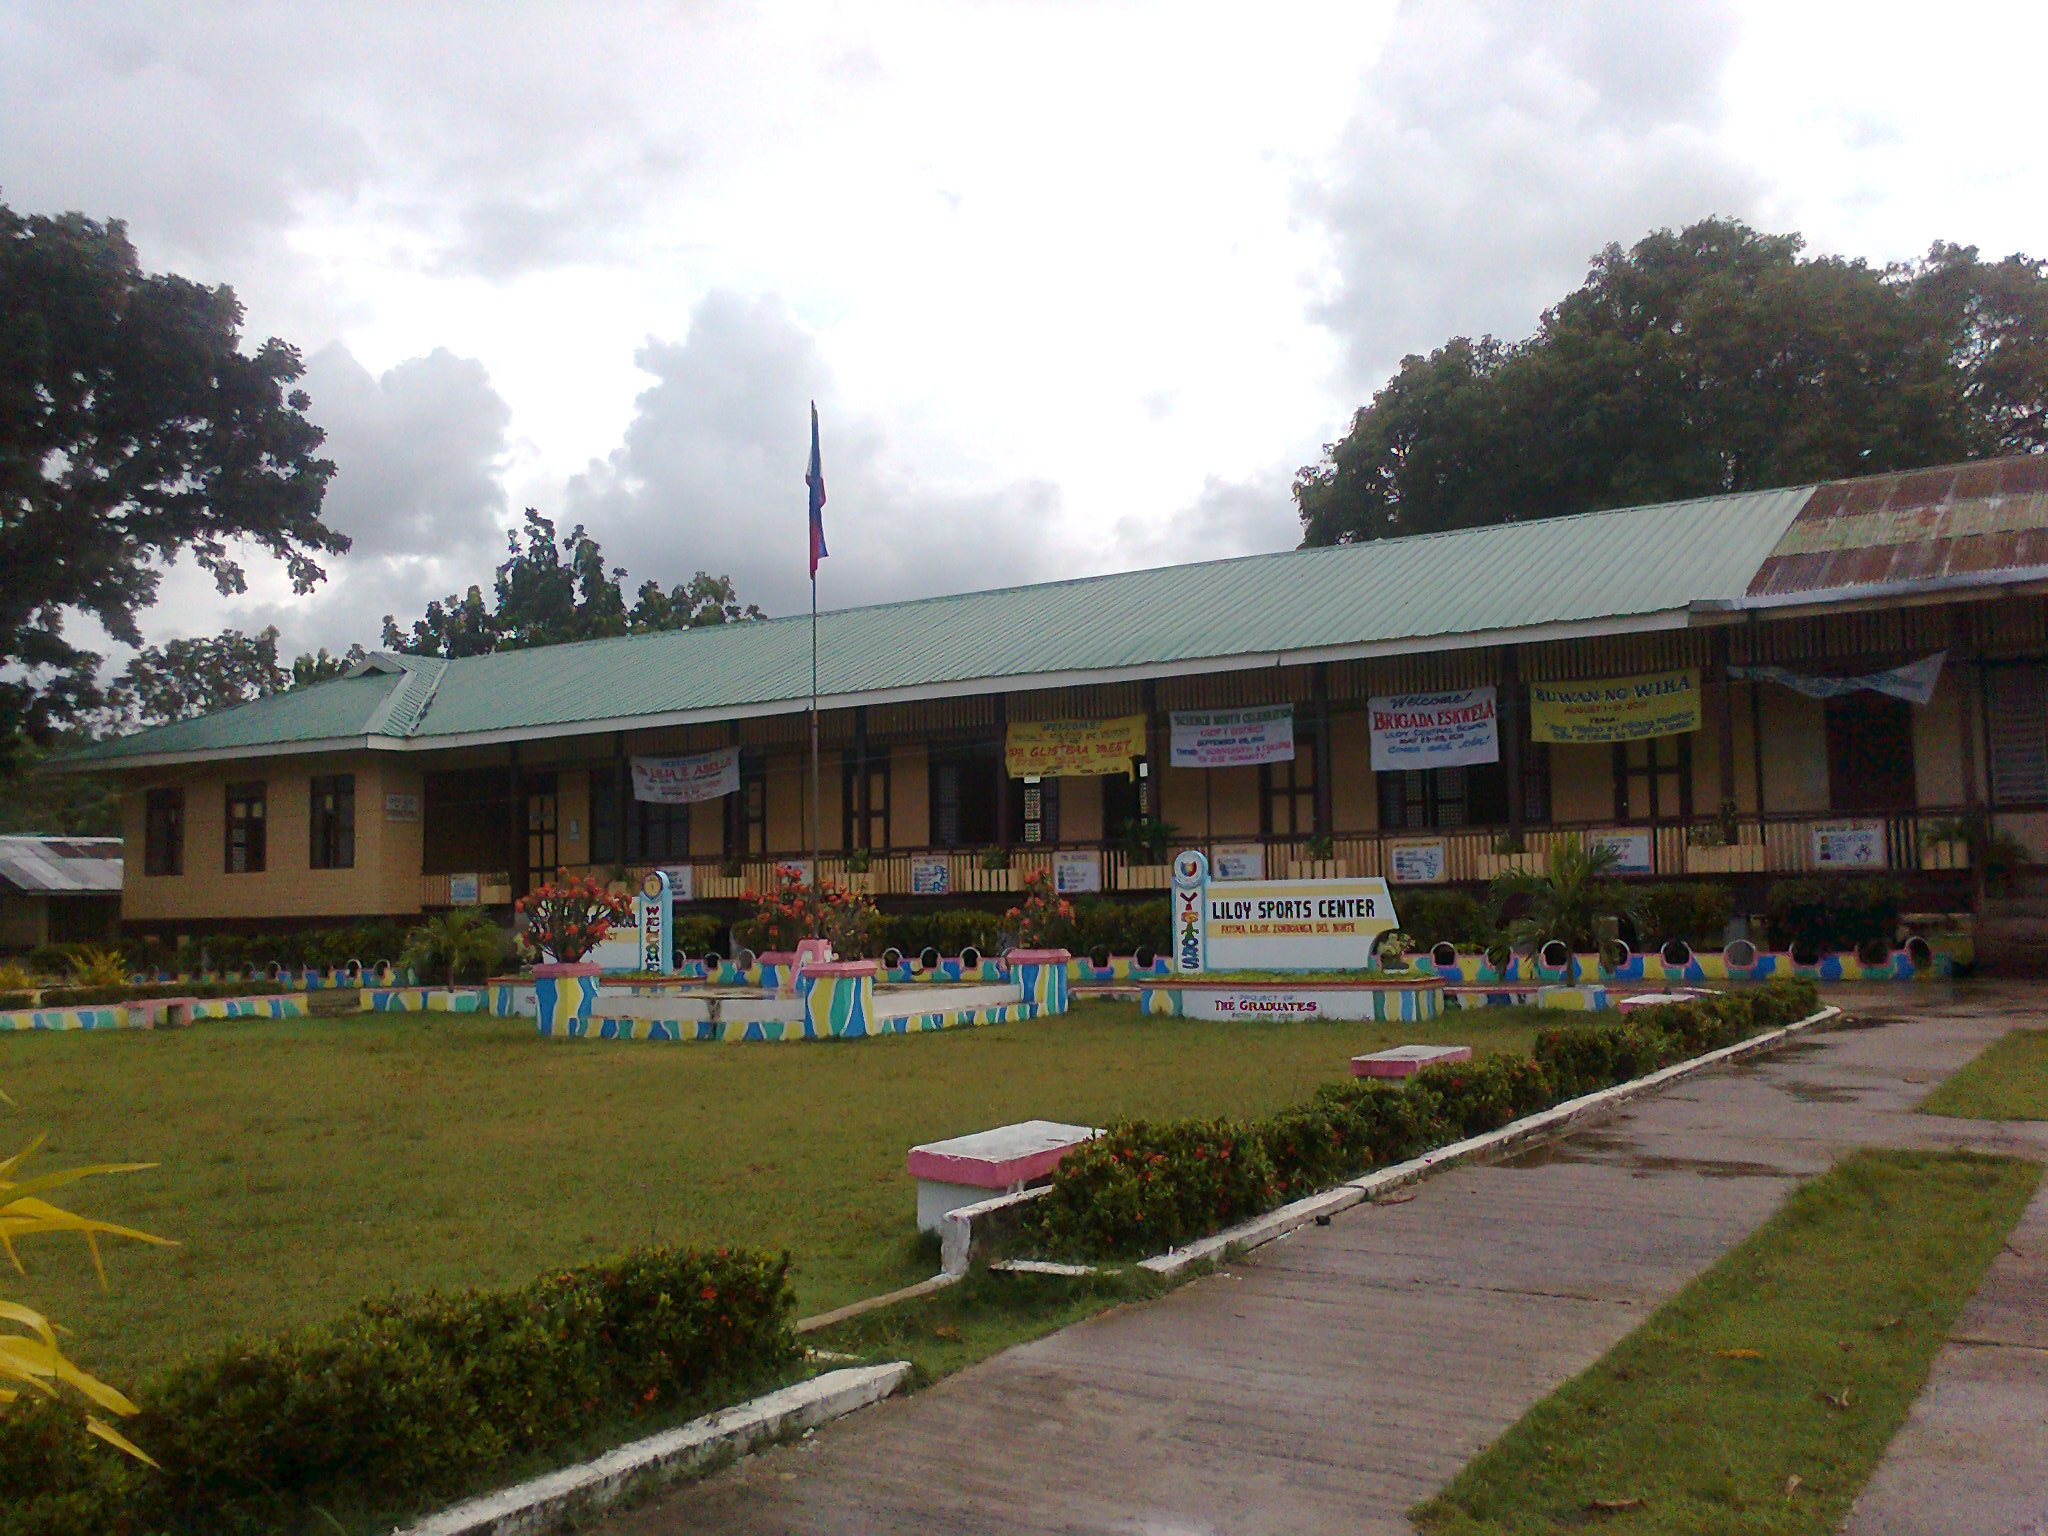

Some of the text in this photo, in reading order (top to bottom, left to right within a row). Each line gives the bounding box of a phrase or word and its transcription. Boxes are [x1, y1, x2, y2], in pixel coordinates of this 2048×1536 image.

[1535, 687, 1600, 702] BUWAN
[1633, 675, 1691, 698] WIKA
[1373, 698, 1494, 730] BRIGADA ESKWELA
[1212, 899, 1375, 919] LILOY SPORTS CENTER
[645, 905, 660, 973] WELCOME
[1214, 999, 1317, 1012] THE GRADUATES
